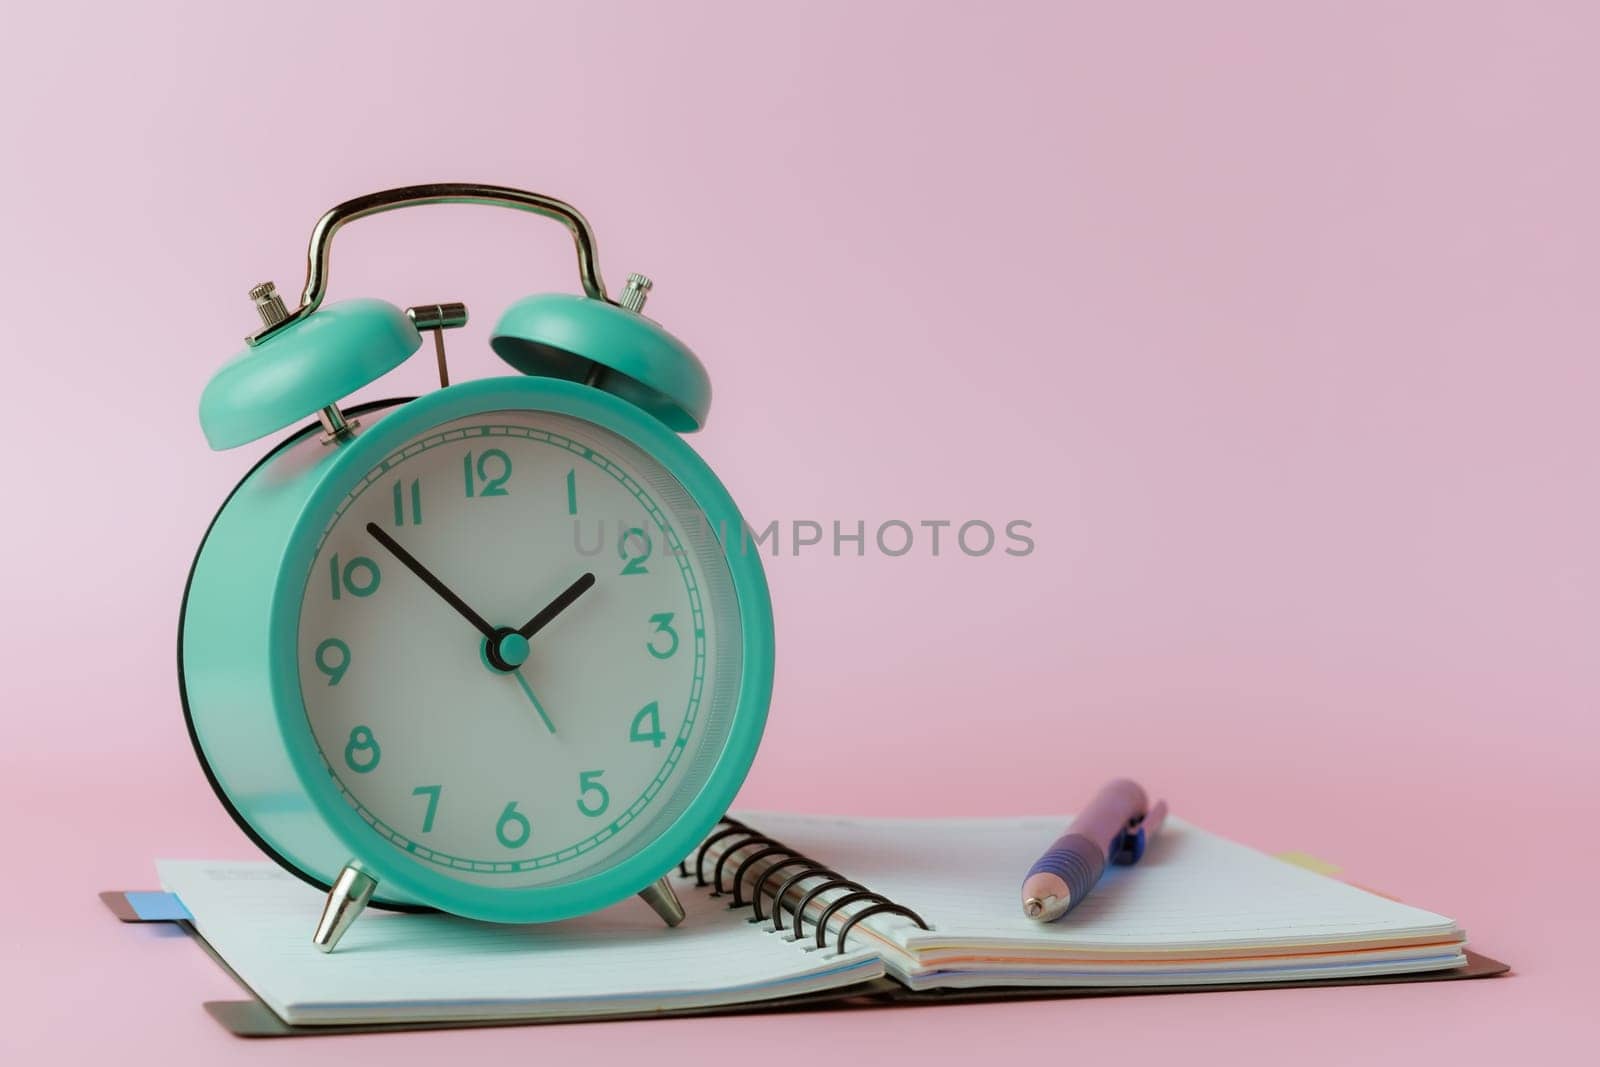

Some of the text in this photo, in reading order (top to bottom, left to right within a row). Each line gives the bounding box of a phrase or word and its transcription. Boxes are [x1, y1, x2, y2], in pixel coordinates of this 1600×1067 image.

[465, 449, 512, 498] 12
[567, 468, 578, 515] 1
[394, 478, 422, 526] 11
[617, 528, 653, 576] 2
[330, 553, 381, 600] 10
[646, 612, 680, 660] 3
[315, 638, 351, 686] 9
[629, 701, 667, 748] 4
[344, 725, 381, 774] 8
[412, 785, 442, 833] 7
[576, 769, 610, 817] 5
[495, 801, 531, 849] 6
